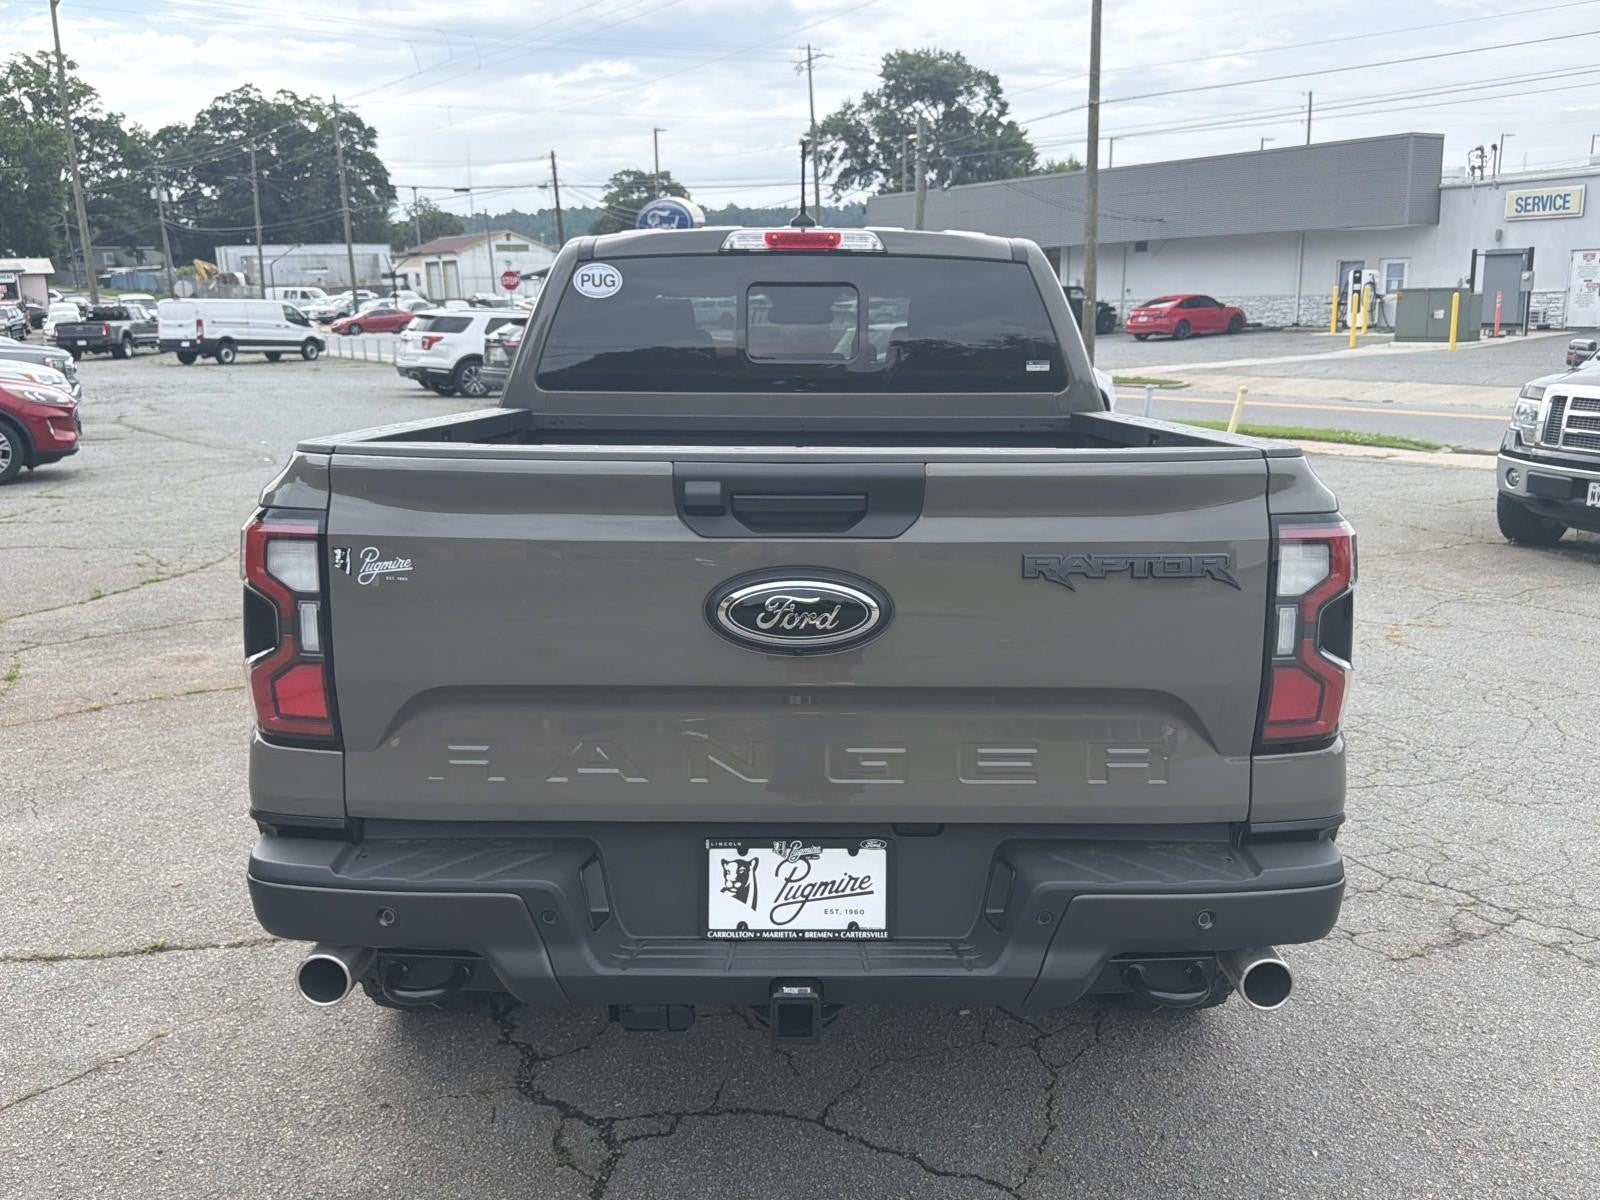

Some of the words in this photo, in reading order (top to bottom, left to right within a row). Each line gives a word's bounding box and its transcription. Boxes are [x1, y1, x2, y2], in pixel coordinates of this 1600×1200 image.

[646, 209, 680, 228] Fd
[1515, 193, 1571, 214] SERVICE
[581, 273, 616, 287] PUG
[357, 546, 414, 585] Pugmire
[1021, 553, 1242, 592] RAPTOR
[756, 595, 841, 630] Ford
[426, 738, 1168, 784] RANGER
[769, 857, 875, 926] Pugmire
